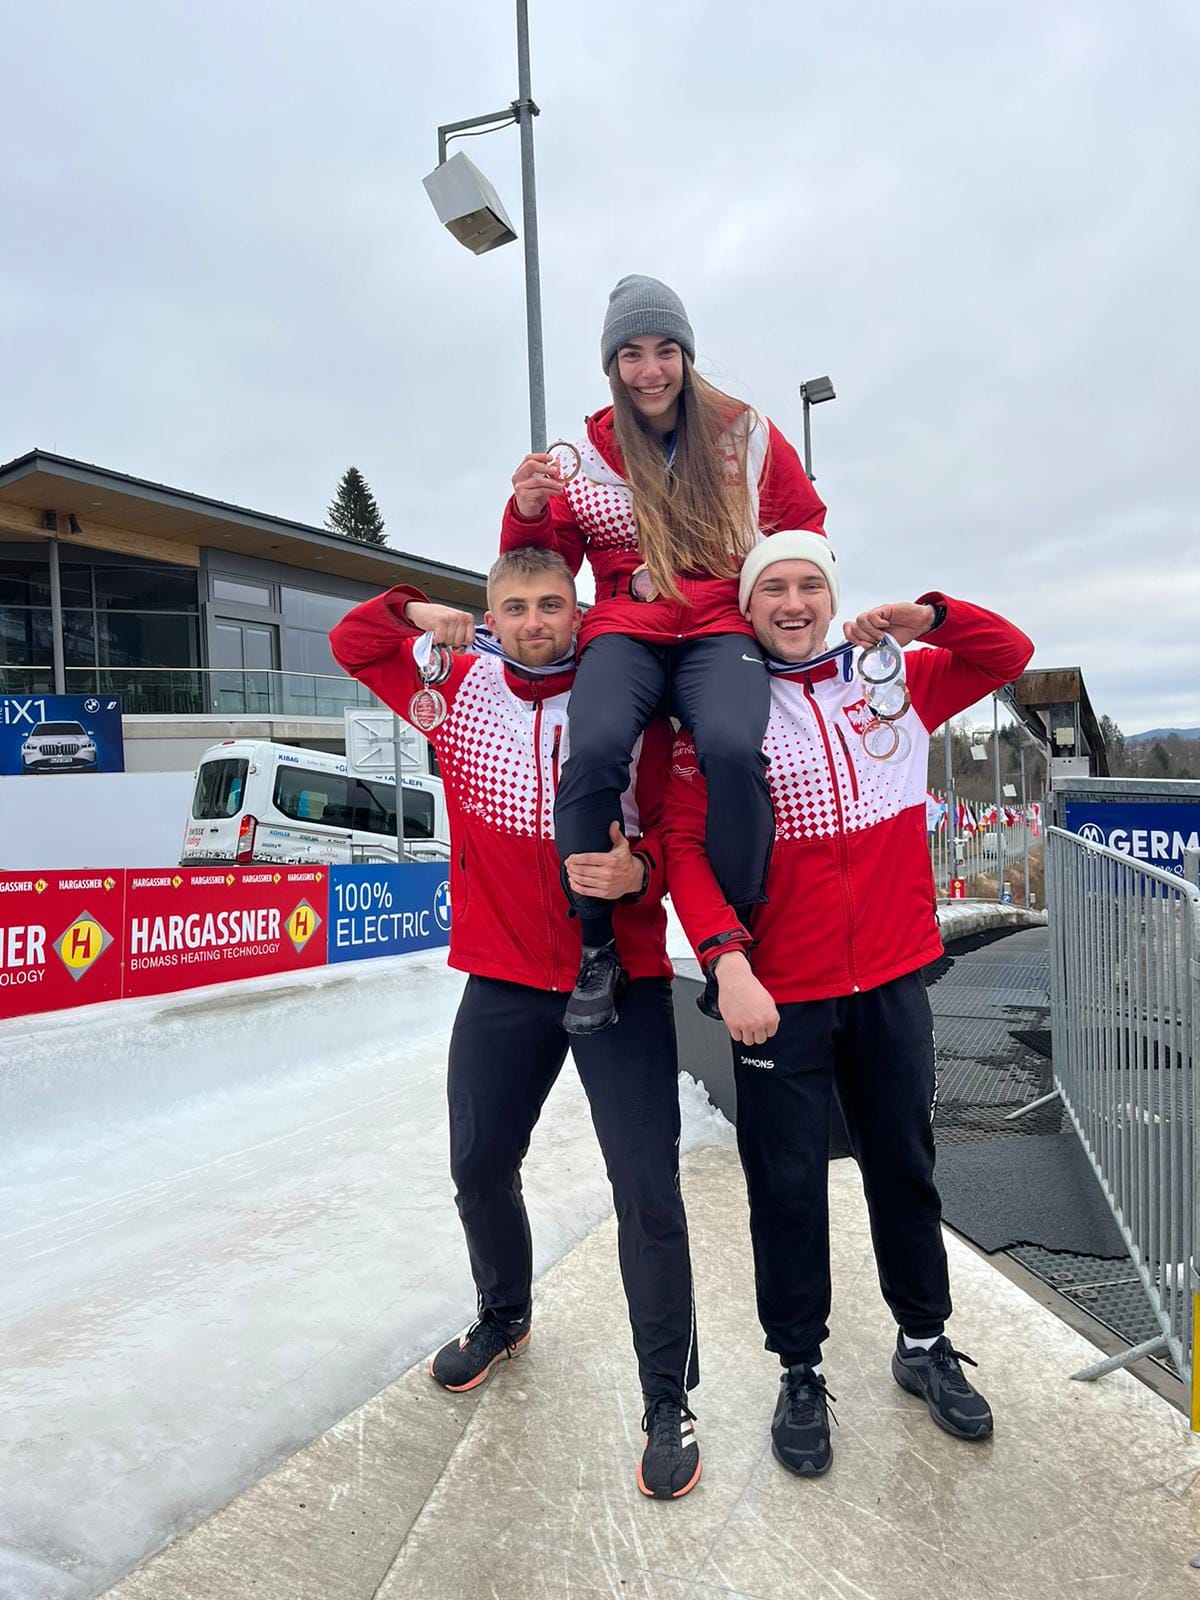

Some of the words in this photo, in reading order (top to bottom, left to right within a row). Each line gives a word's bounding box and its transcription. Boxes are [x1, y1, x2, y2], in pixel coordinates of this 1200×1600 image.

[4, 699, 46, 724] iX1
[1108, 829, 1200, 859] GERM
[59, 879, 102, 890] HARGASSNER
[132, 877, 171, 888] HARGASSNER
[190, 875, 224, 885] HARGASSNER
[242, 873, 272, 883] HARGASSNER
[287, 873, 314, 881] HARGASSNER
[0, 881, 33, 892] GASSNER
[335, 882, 393, 912] 100%
[131, 908, 280, 954] HARGASSNER
[336, 910, 430, 947] ELECTRIC
[130, 954, 178, 971] BIOMASS
[180, 948, 221, 964] HEATING
[224, 943, 280, 958] TECHNOLOGY
